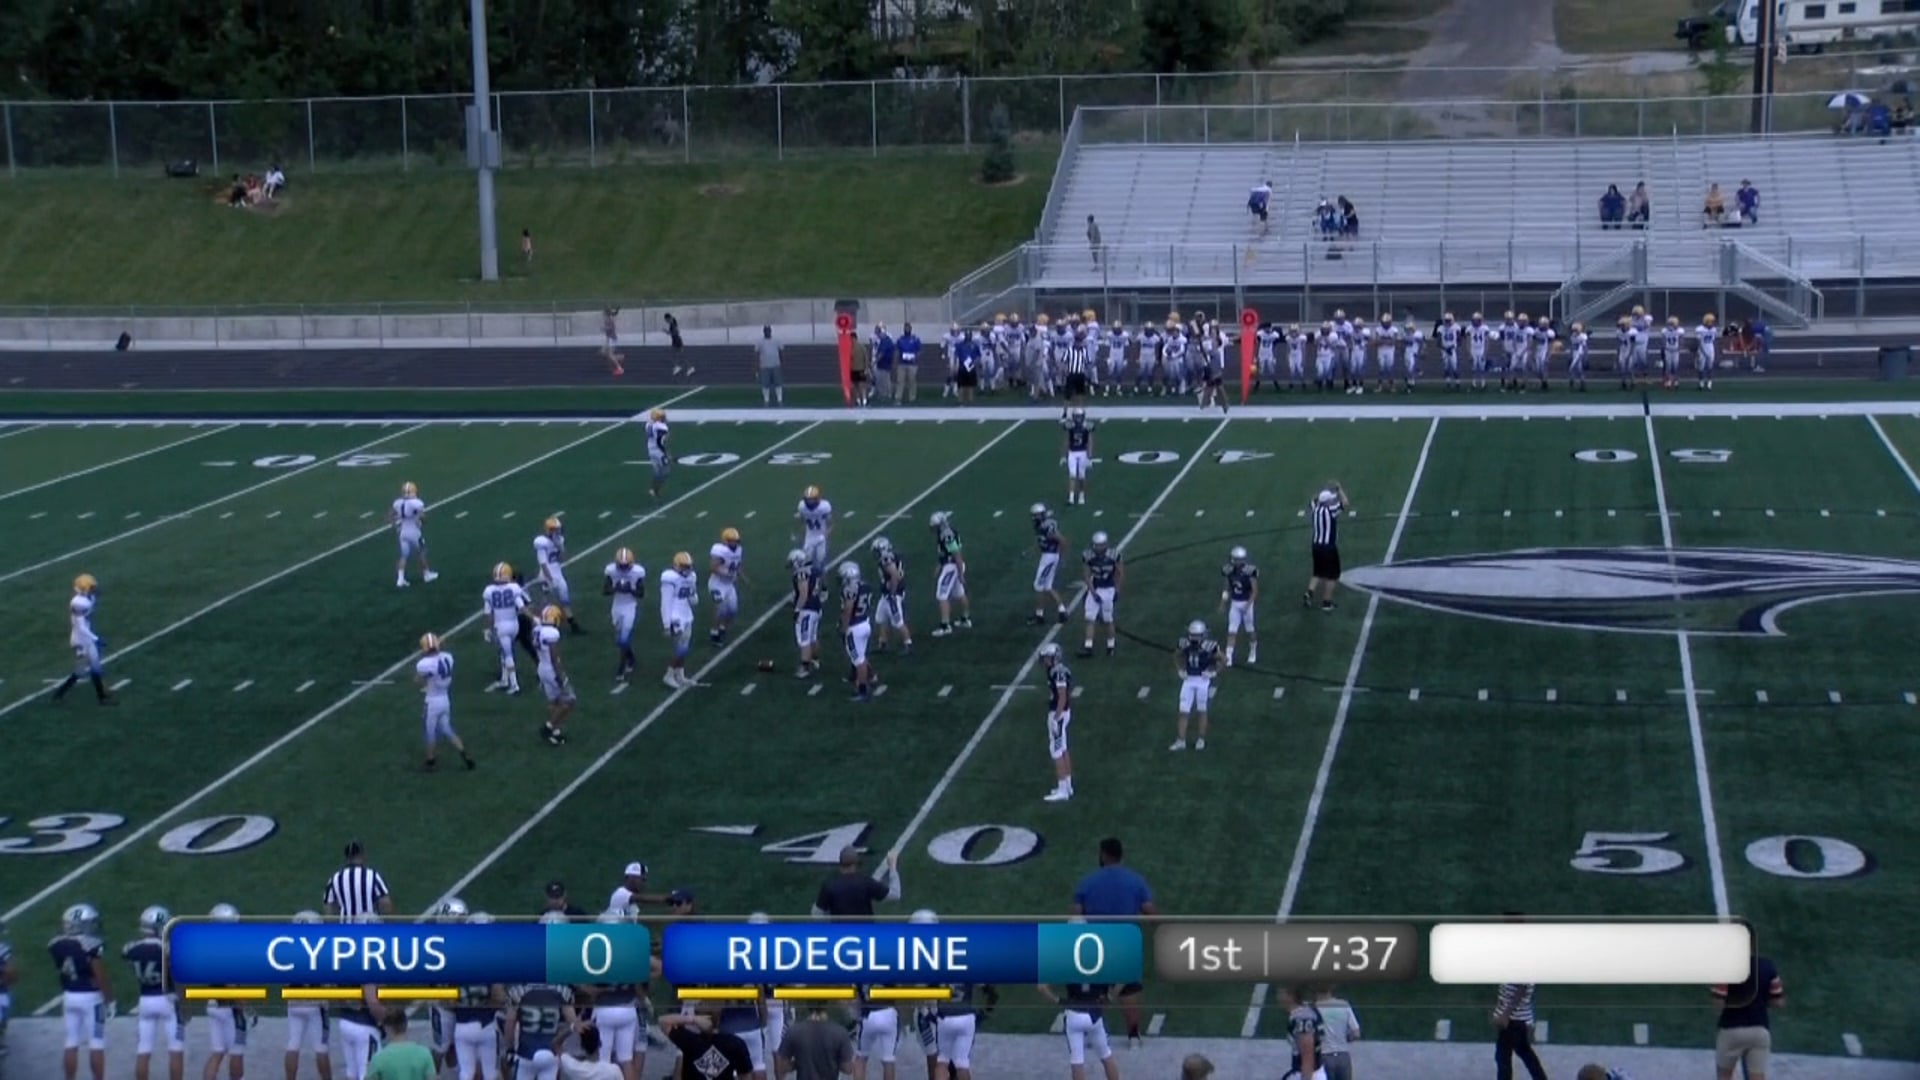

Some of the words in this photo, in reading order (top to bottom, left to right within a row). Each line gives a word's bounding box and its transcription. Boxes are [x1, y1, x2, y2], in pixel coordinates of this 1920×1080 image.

[1073, 432, 1082, 446] 5
[1232, 580, 1243, 596] 2
[1186, 654, 1198, 669] 11
[62, 955, 78, 981] 4
[133, 960, 161, 985] 16
[521, 1006, 558, 1034] 33
